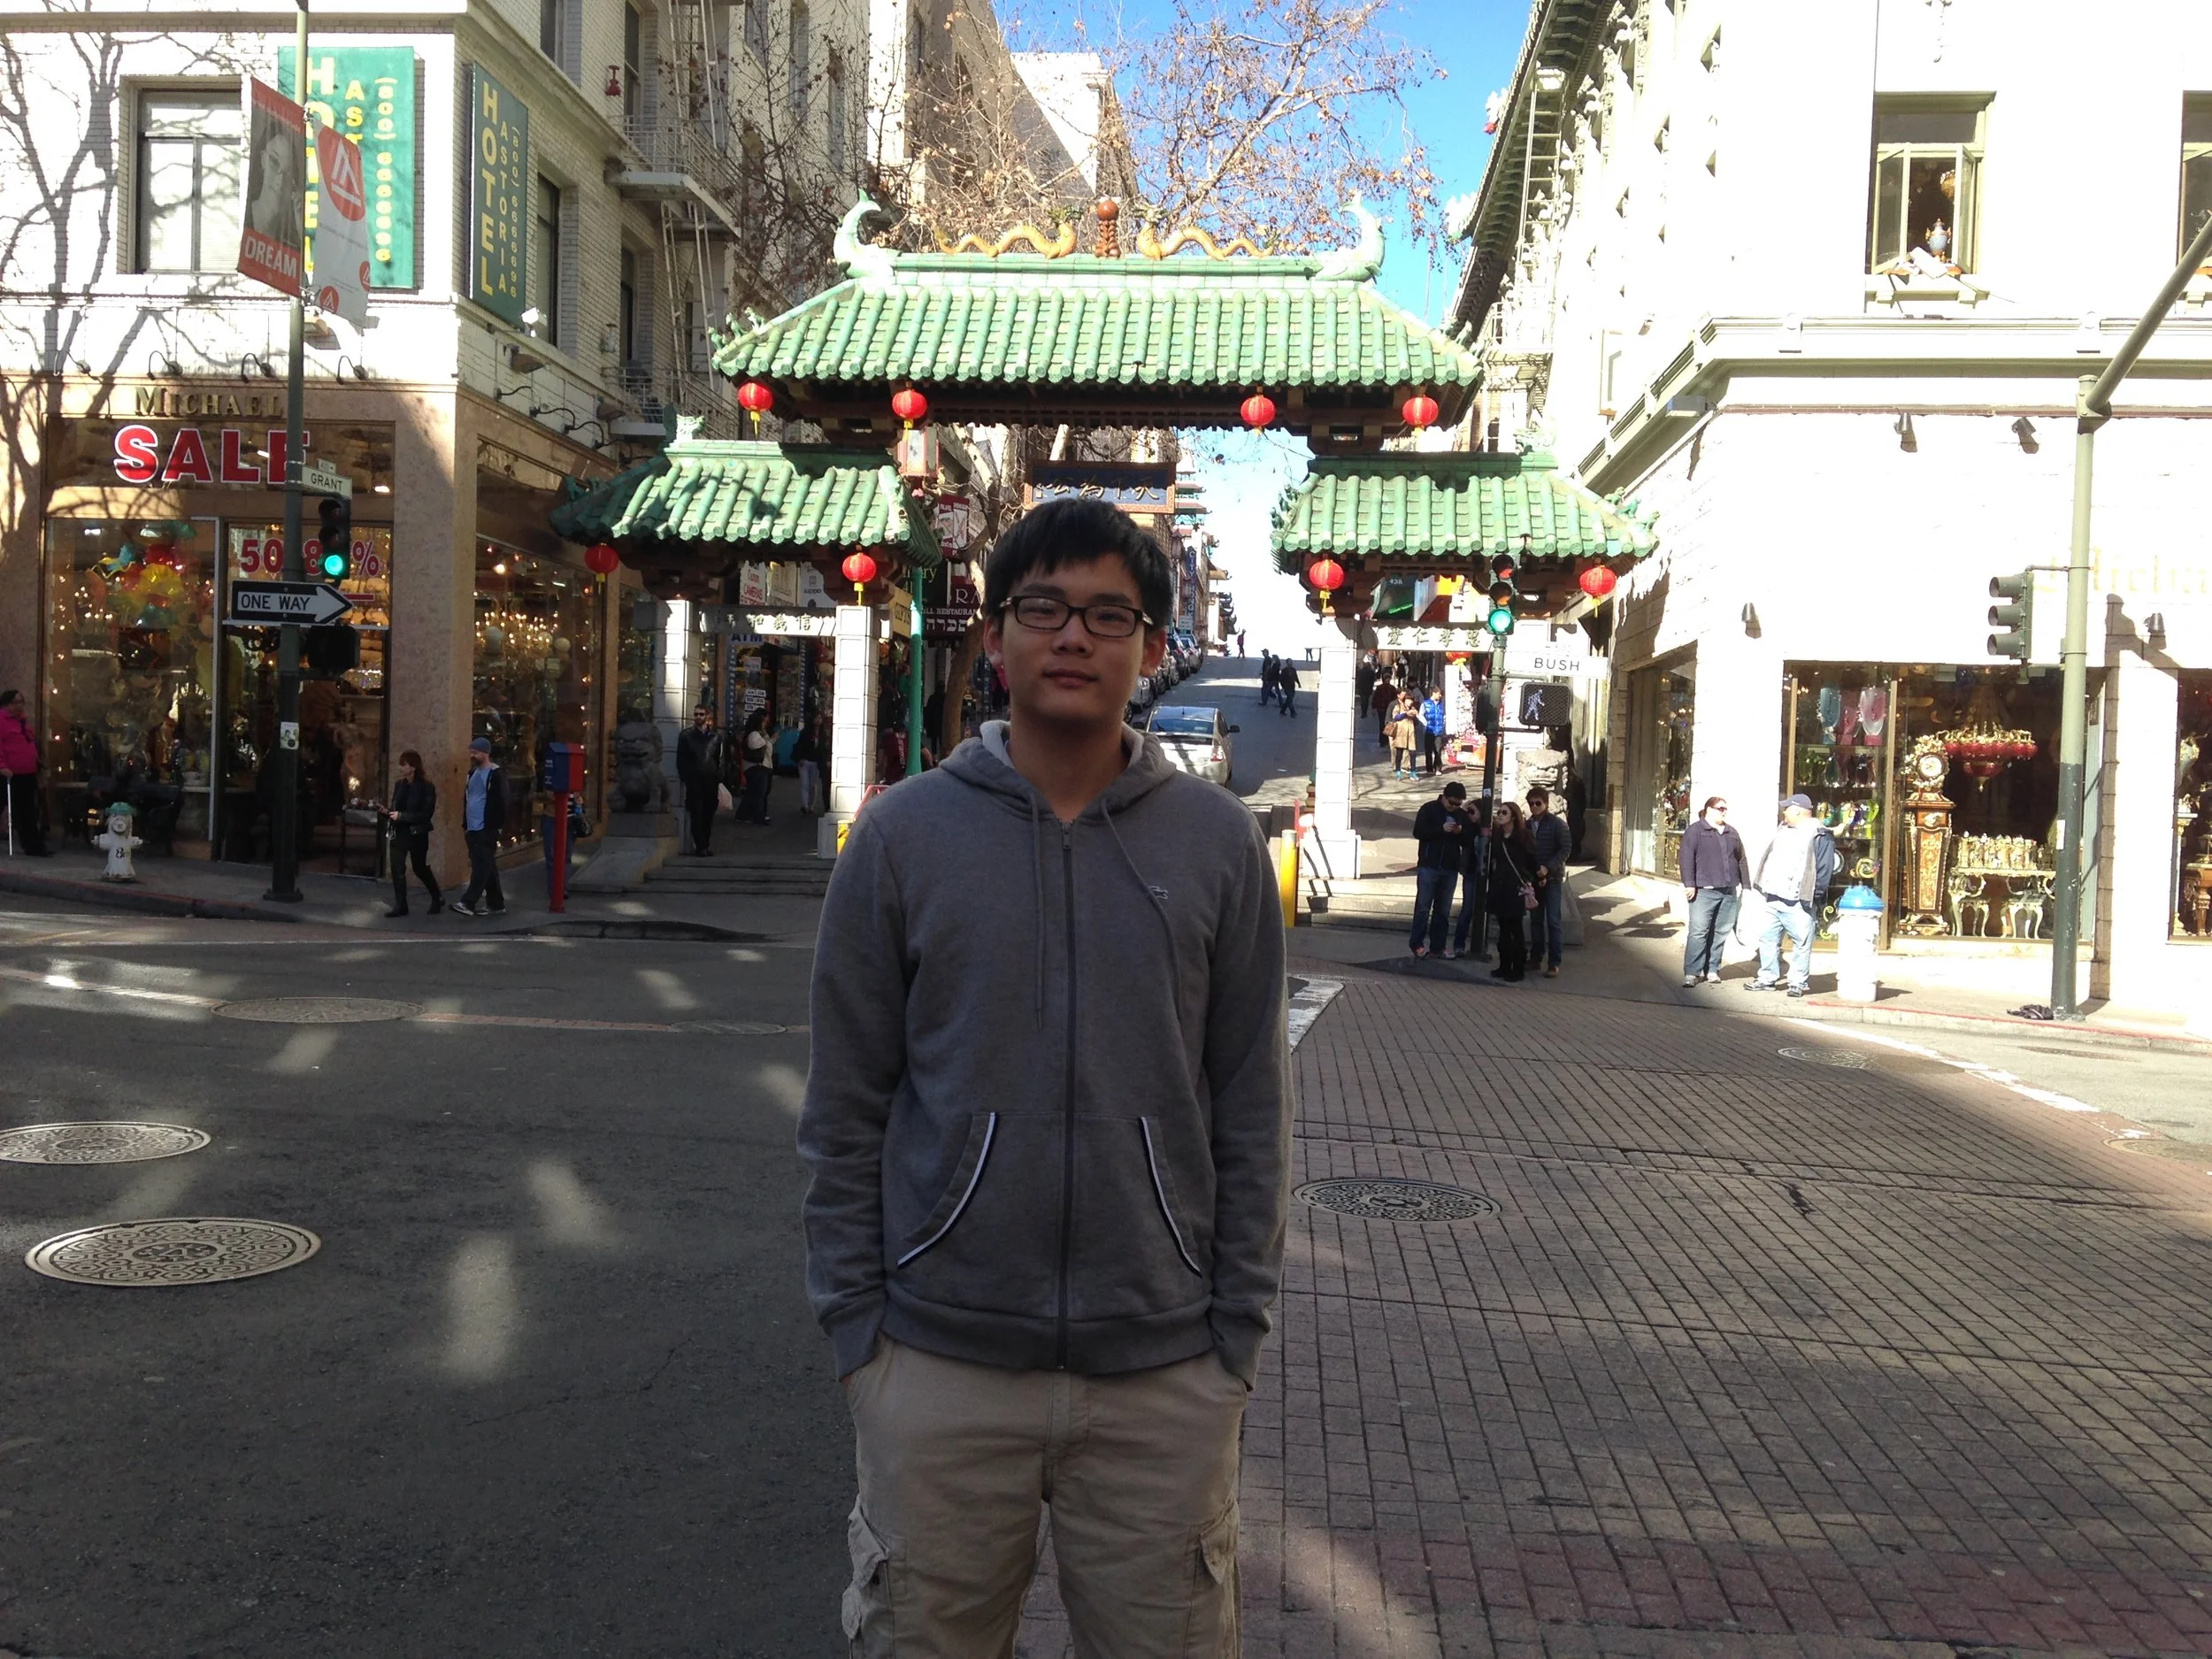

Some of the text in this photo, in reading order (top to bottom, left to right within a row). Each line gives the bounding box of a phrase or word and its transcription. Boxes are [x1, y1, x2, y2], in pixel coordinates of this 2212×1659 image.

[481, 81, 498, 297] HOTEL
[498, 119, 509, 293] ASTORIA
[244, 235, 298, 279] DREAM
[134, 387, 285, 417] MICHAEL
[113, 425, 311, 485] SALE
[310, 472, 343, 492] GRANT
[241, 594, 311, 611] ONE WAY
[1533, 657, 1580, 672] BUSH
